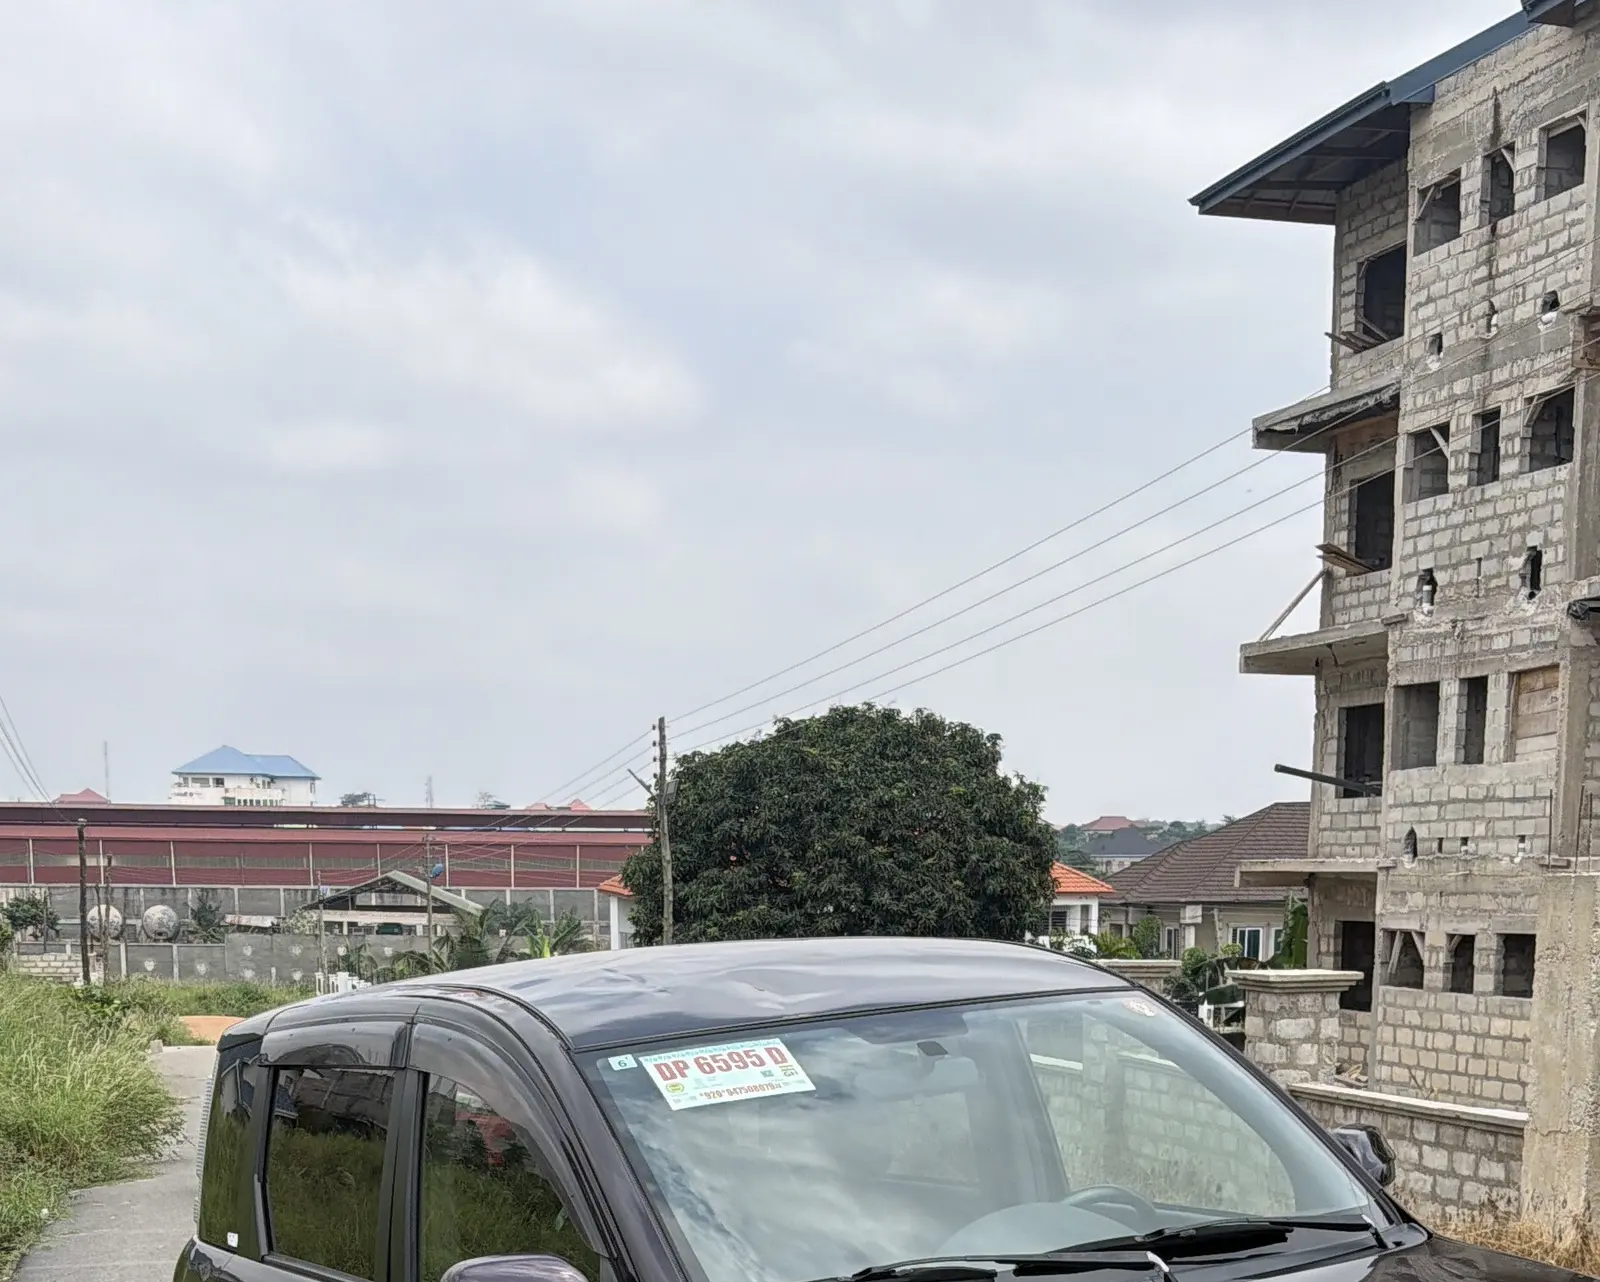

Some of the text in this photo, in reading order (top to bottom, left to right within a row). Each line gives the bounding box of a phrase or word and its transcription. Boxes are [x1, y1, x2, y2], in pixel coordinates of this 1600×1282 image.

[653, 1060, 690, 1081] DP
[694, 1049, 766, 1074] 6595
[764, 1047, 788, 1065] D
